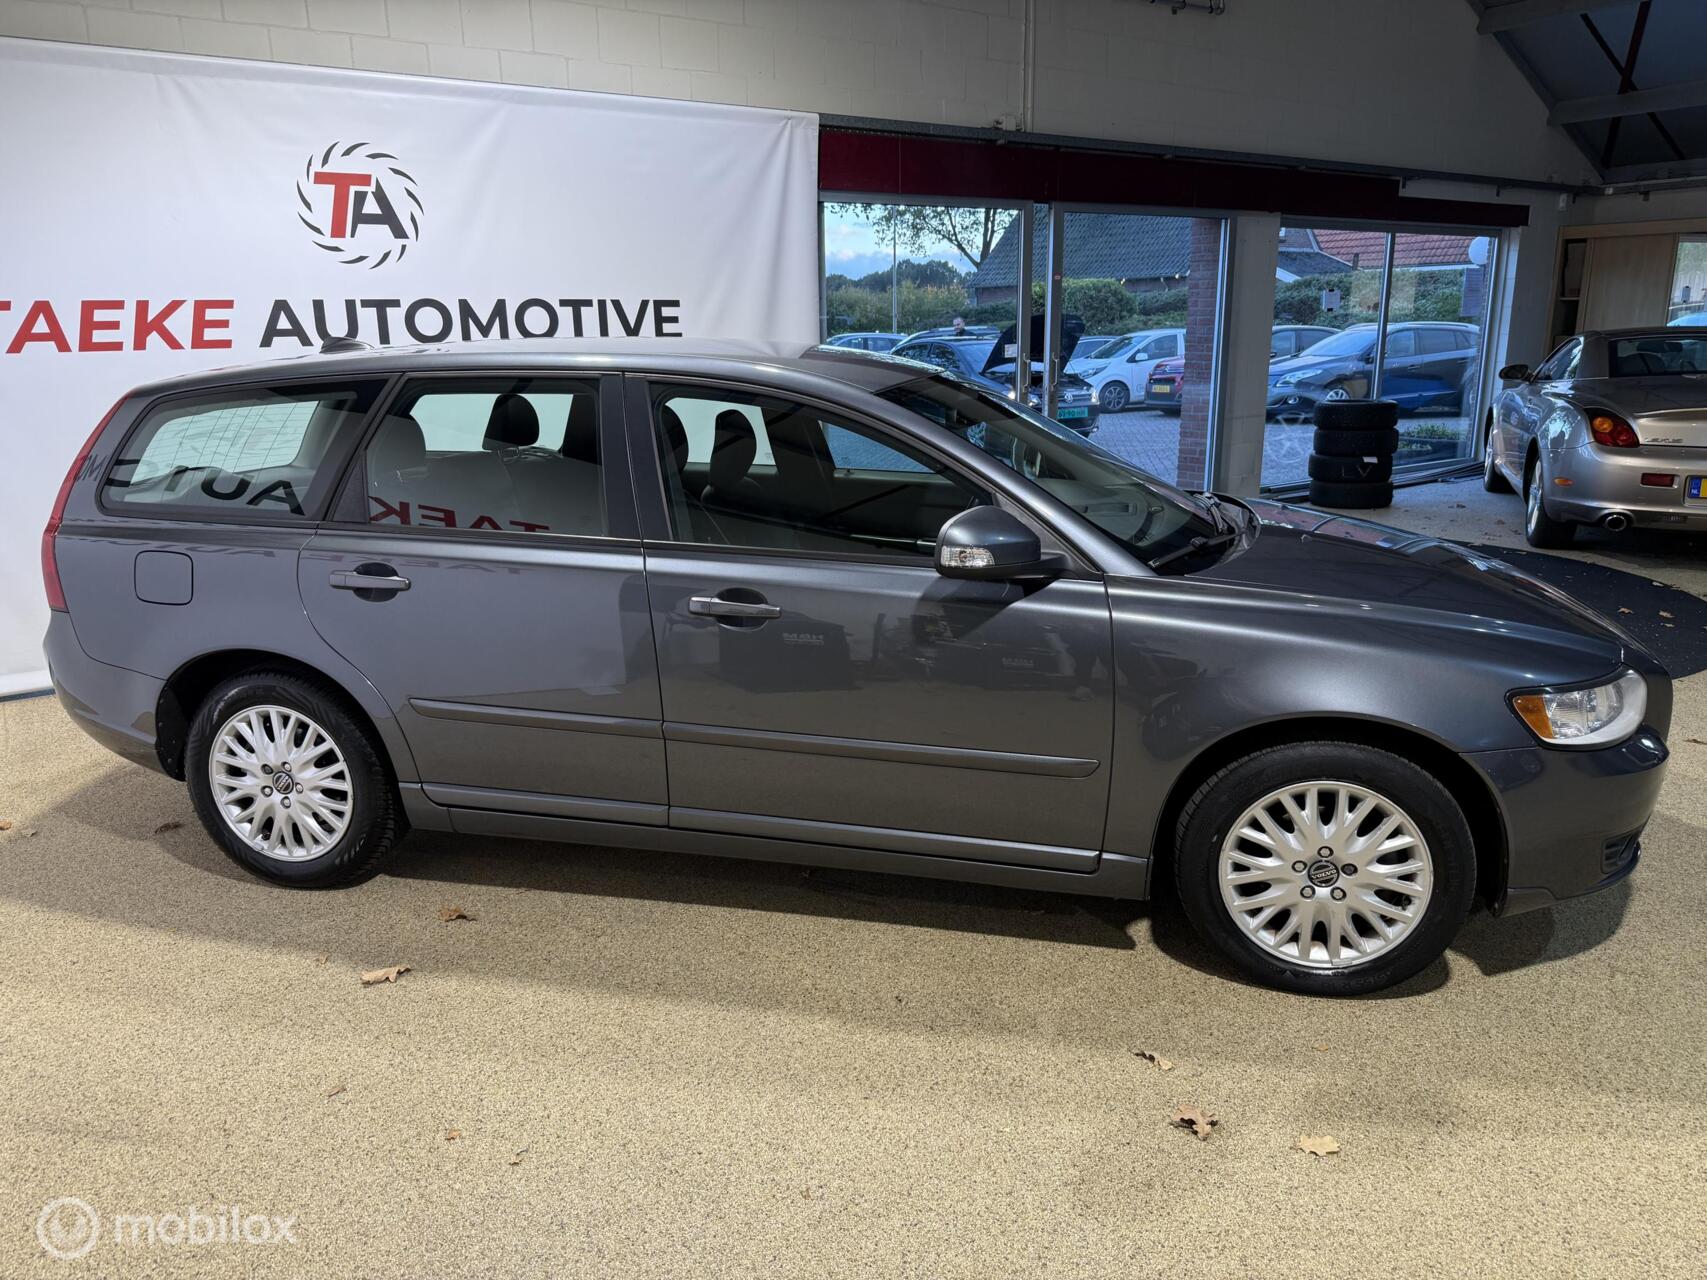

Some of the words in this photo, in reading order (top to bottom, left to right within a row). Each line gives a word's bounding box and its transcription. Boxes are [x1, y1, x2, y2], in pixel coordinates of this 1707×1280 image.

[313, 171, 410, 239] TA
[259, 298, 683, 348] AUTOMOTIVE
[1311, 869, 1337, 879] VOLVO
